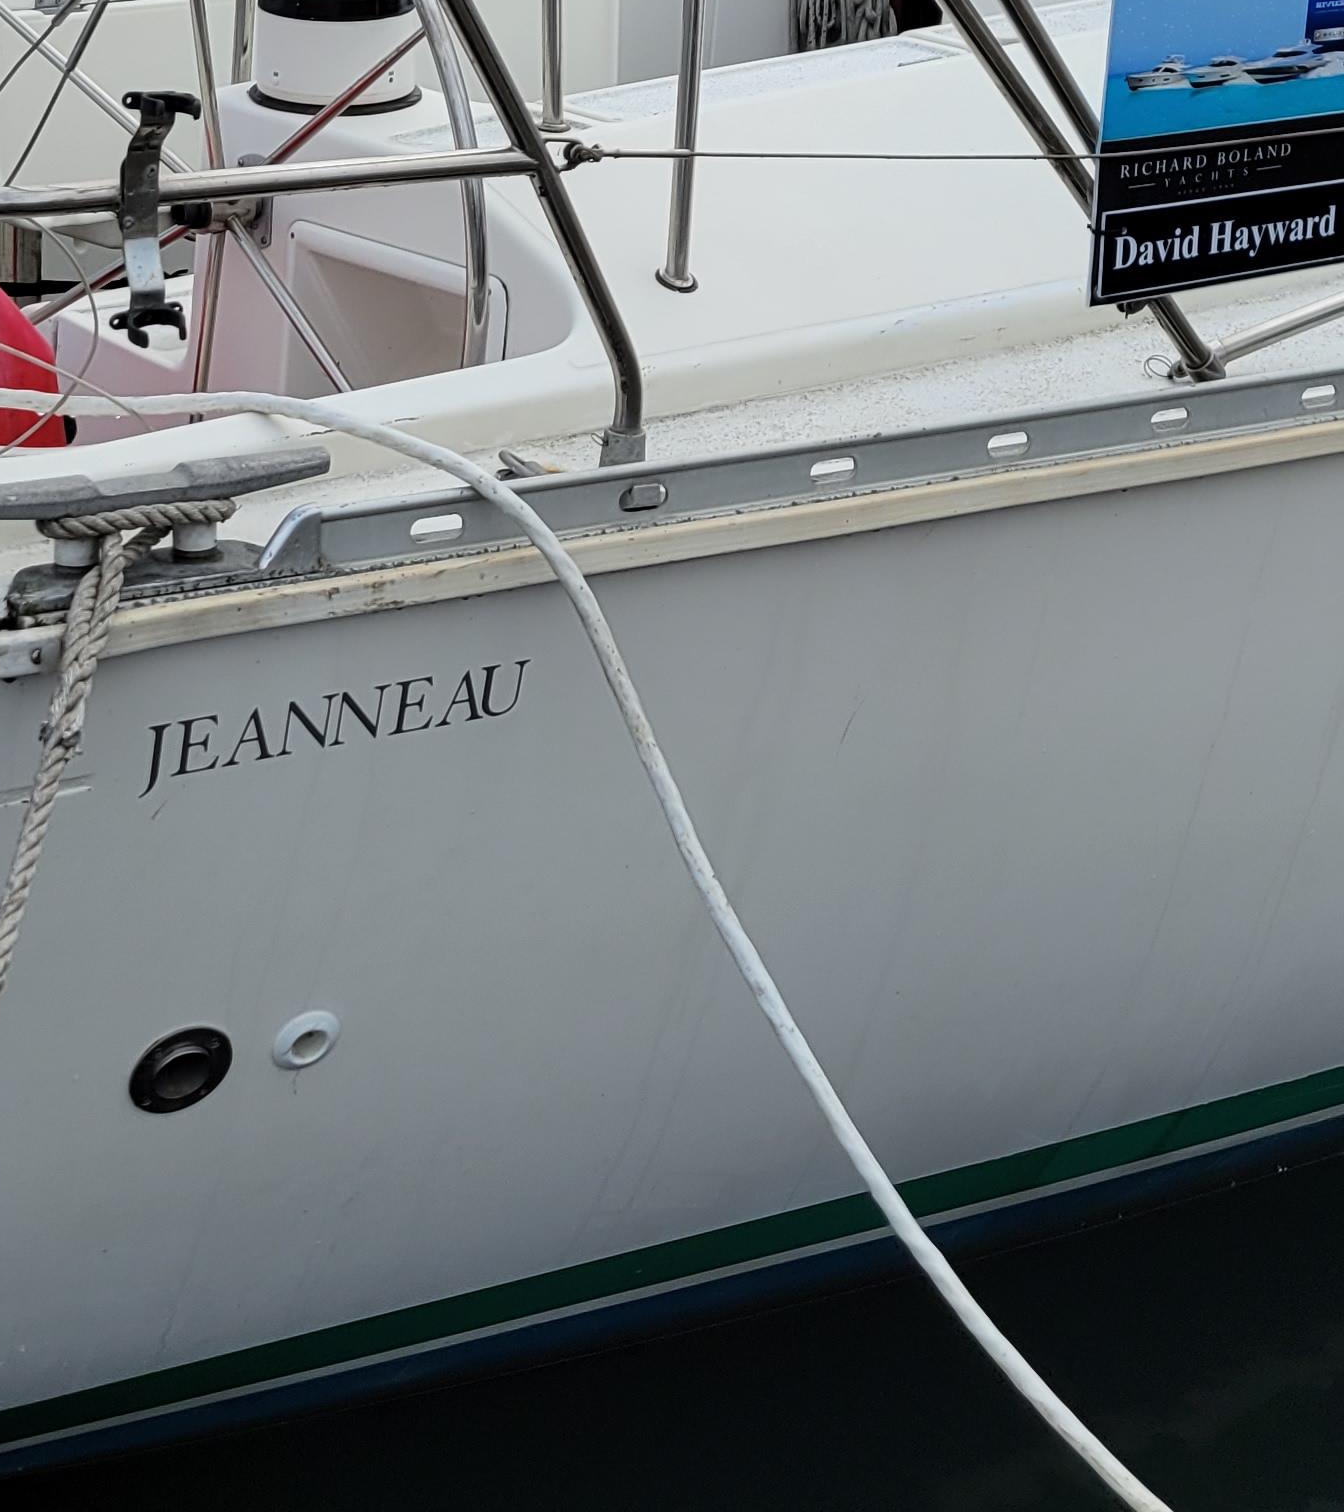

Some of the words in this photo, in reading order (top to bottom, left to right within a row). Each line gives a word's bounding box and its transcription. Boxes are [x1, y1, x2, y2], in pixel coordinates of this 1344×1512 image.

[1120, 154, 1207, 180] RICHARD
[1217, 143, 1292, 166] BOLAND
[1164, 166, 1249, 188] YACHTS
[1113, 228, 1200, 271] David
[1208, 205, 1335, 257] Hayward
[138, 659, 531, 799] JEANNEAU
